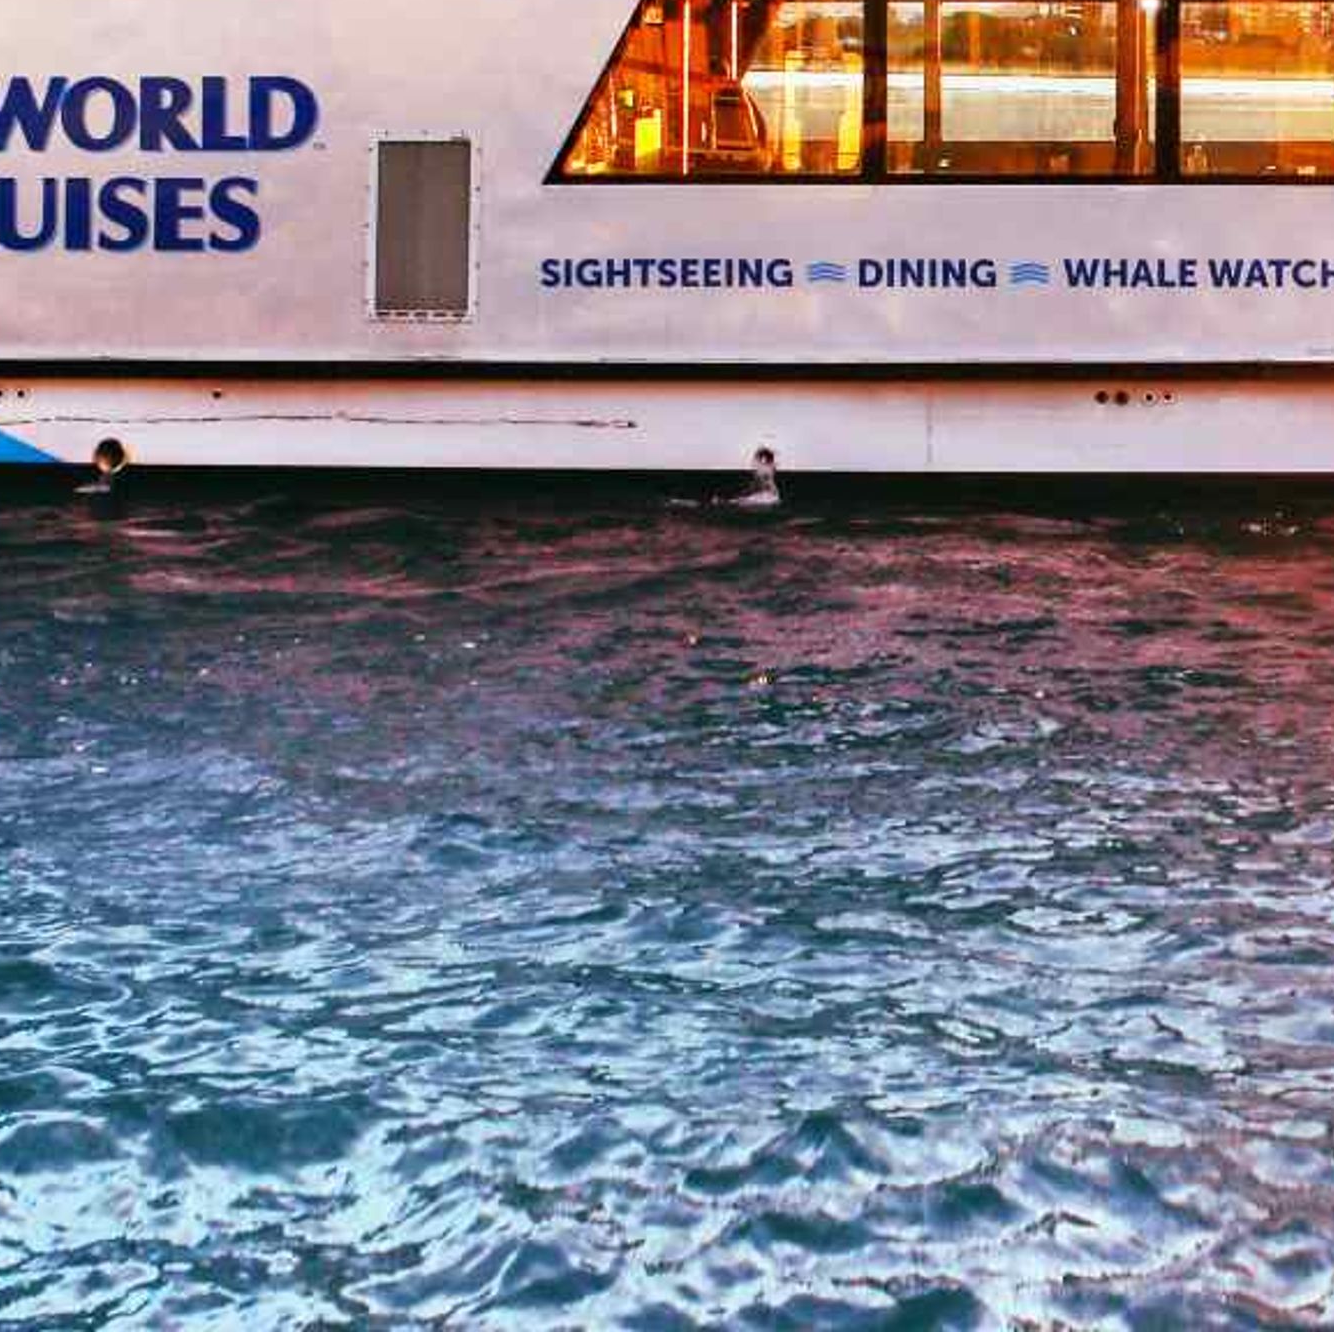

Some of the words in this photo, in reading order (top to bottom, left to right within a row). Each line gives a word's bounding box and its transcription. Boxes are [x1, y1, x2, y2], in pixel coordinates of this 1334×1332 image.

[541, 259, 793, 287] SIGHTSEEING
[859, 259, 996, 287] DINING
[1064, 259, 1197, 288] WHALE
